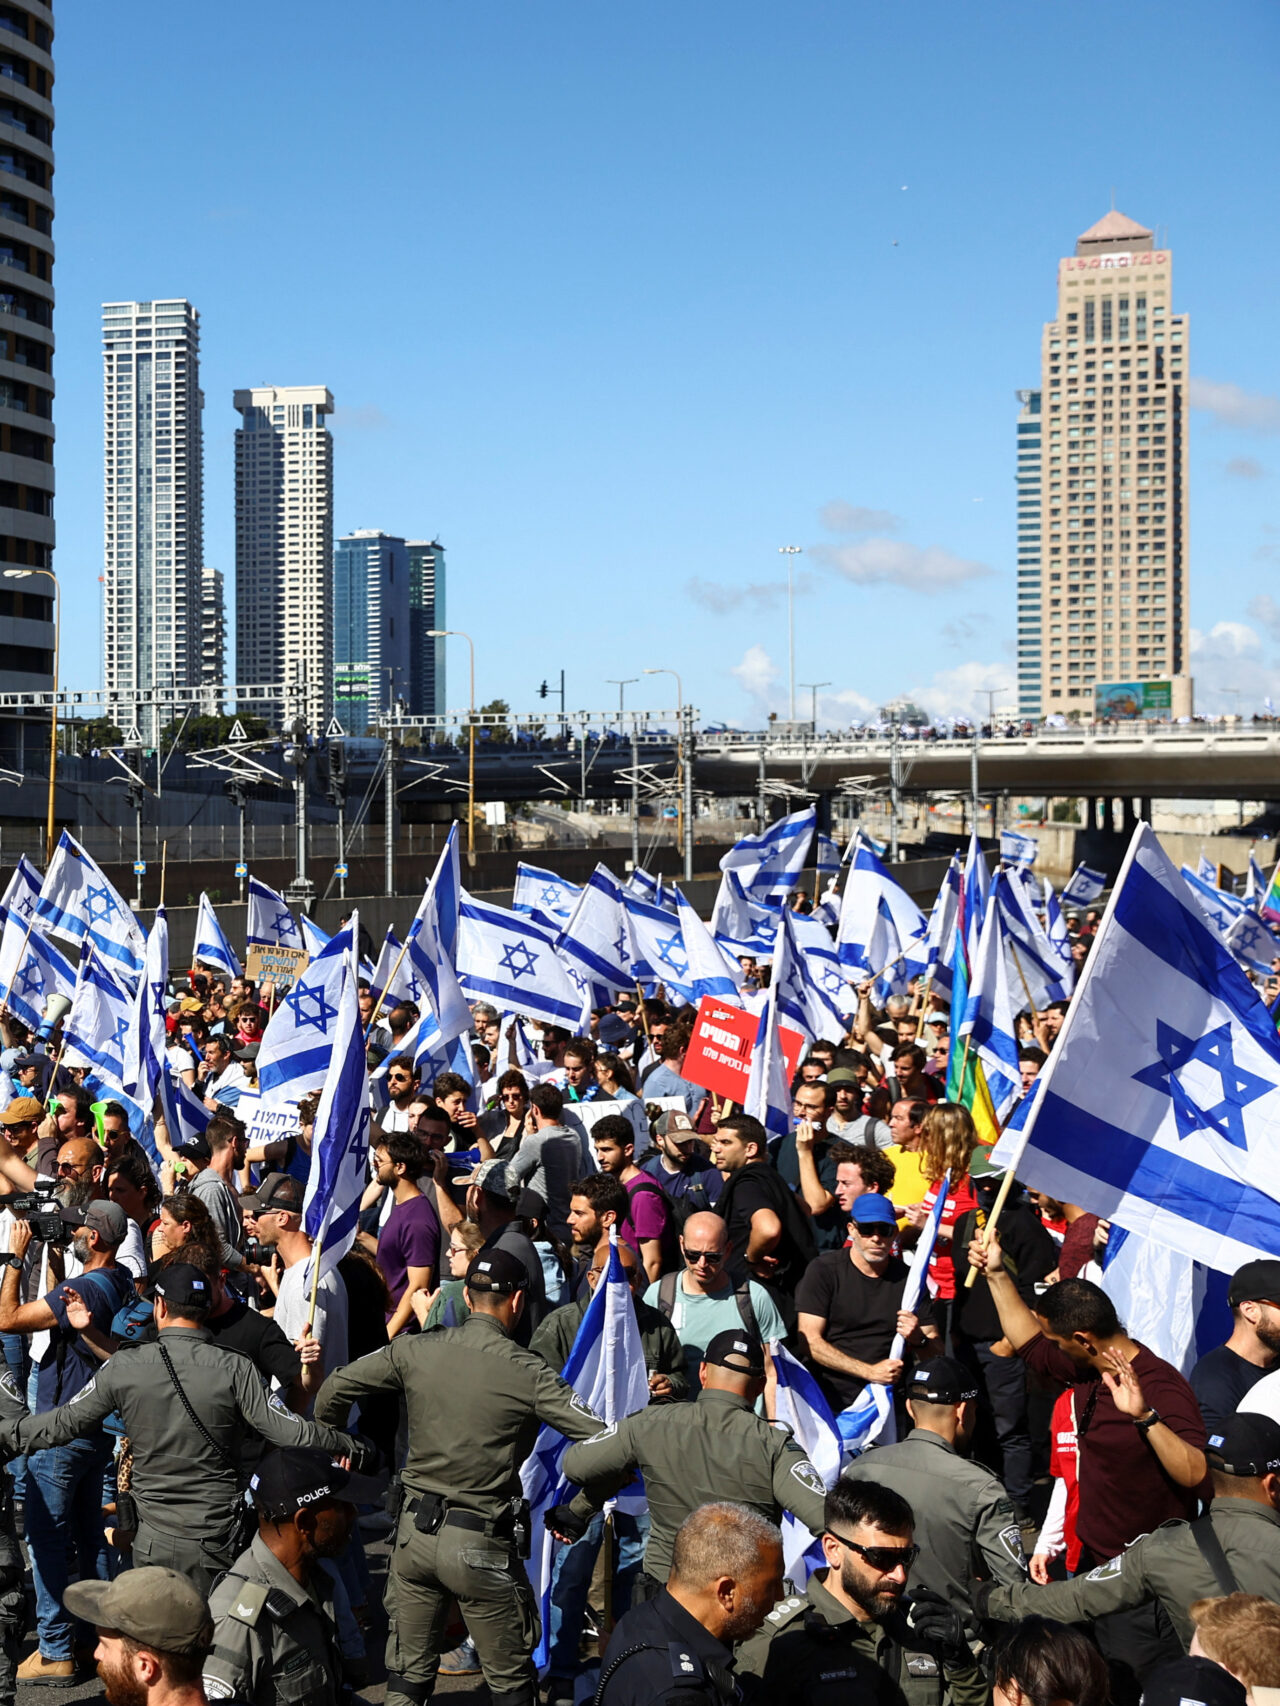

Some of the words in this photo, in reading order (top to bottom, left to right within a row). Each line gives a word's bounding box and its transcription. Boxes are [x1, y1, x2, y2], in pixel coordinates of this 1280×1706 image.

[1065, 251, 1167, 271] Leonardo
[252, 1109, 301, 1129] לחמות
[296, 1485, 331, 1507] POLICE
